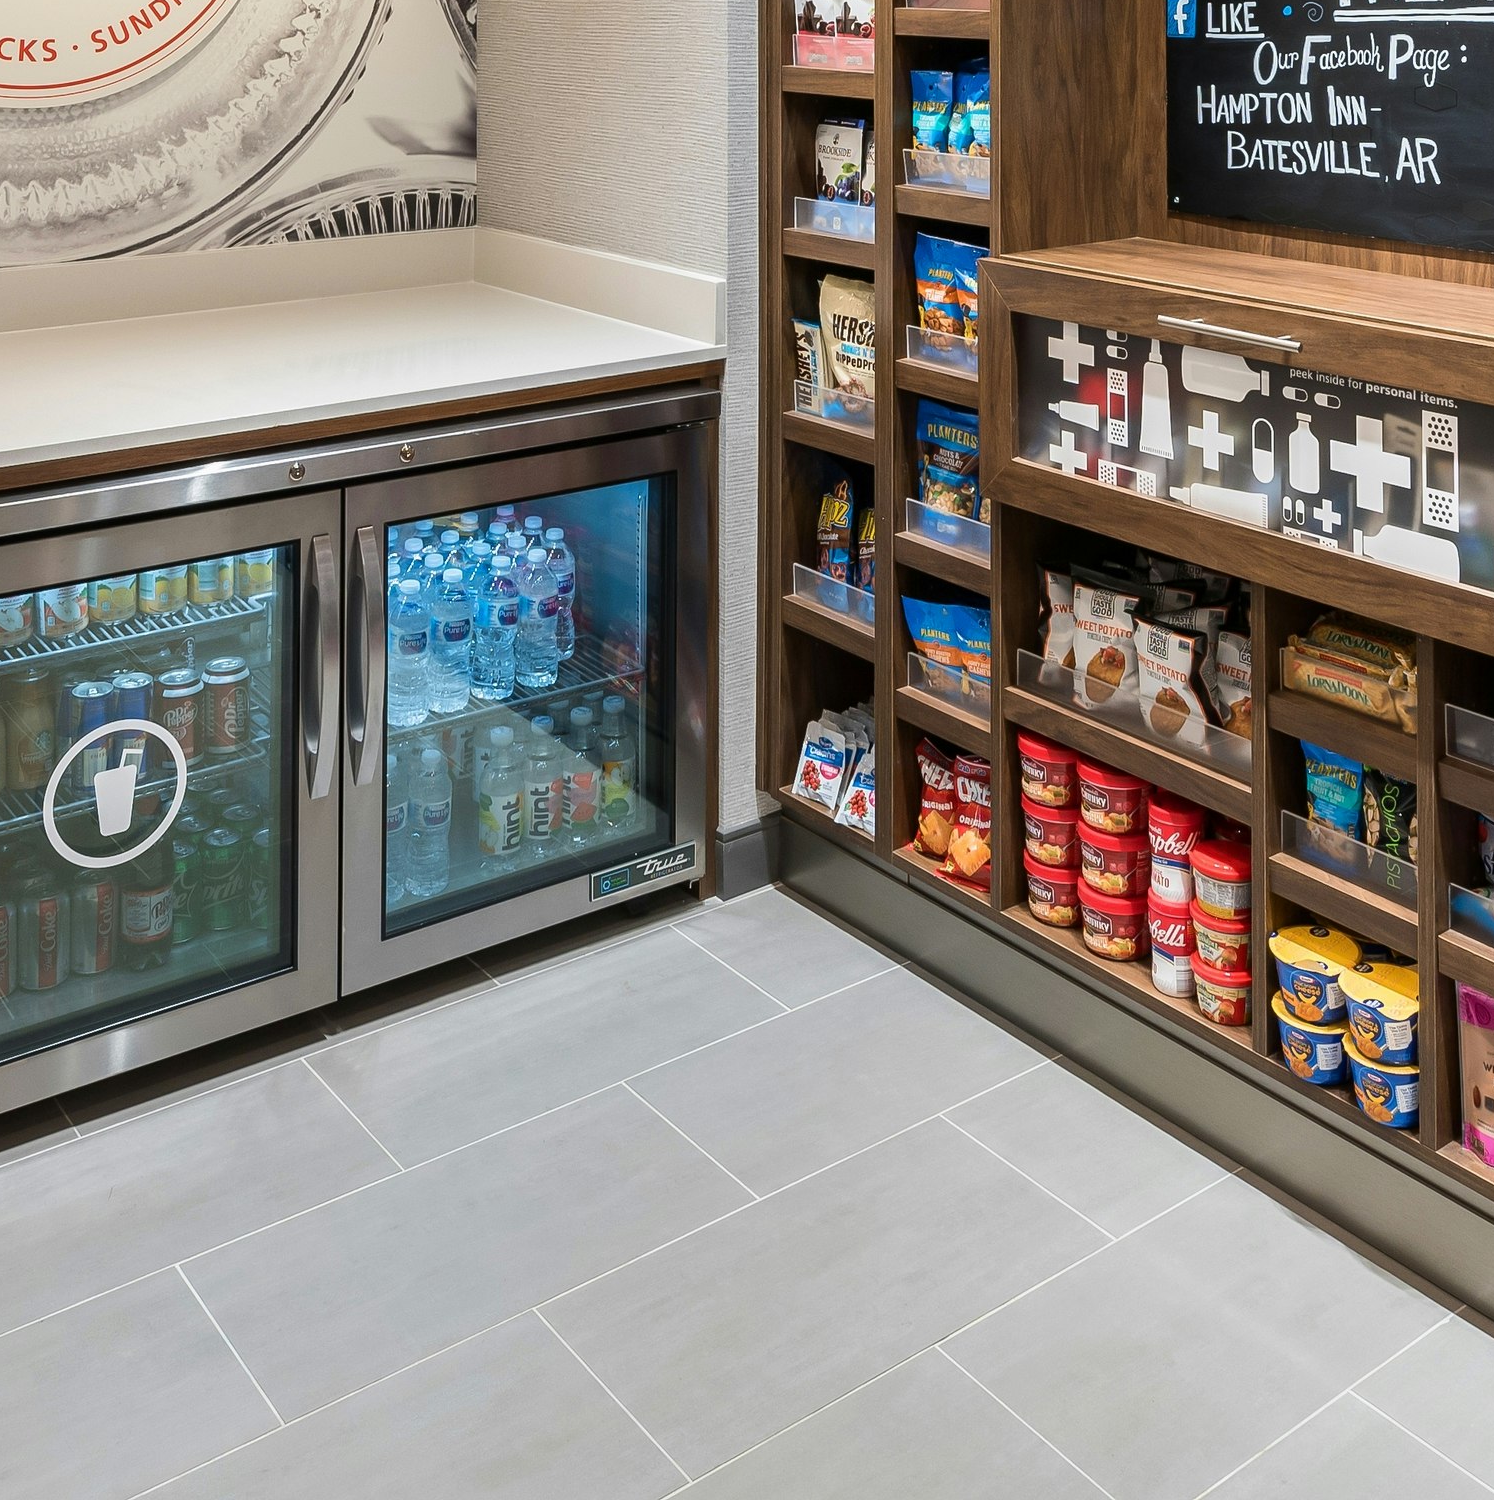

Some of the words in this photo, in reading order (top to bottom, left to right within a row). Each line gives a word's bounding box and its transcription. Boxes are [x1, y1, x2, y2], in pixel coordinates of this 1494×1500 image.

[1207, 2, 1257, 35] LIKE
[1254, 39, 1298, 86] Our
[1299, 36, 1384, 85] Facebook
[1196, 85, 1313, 124] HAMPTON
[1395, 137, 1442, 185] AR
[1289, 366, 1314, 382] peek
[1316, 372, 1345, 388] inside
[1347, 377, 1363, 390] for
[1366, 382, 1416, 402] personal
[1420, 390, 1458, 409] items.
[927, 423, 978, 449] PLANTERS
[1092, 607, 1112, 617] GOOD
[1093, 600, 1112, 610] TASTE
[1097, 623, 1133, 639] POTATO
[502, 798, 521, 851] hint
[529, 786, 550, 837] hint
